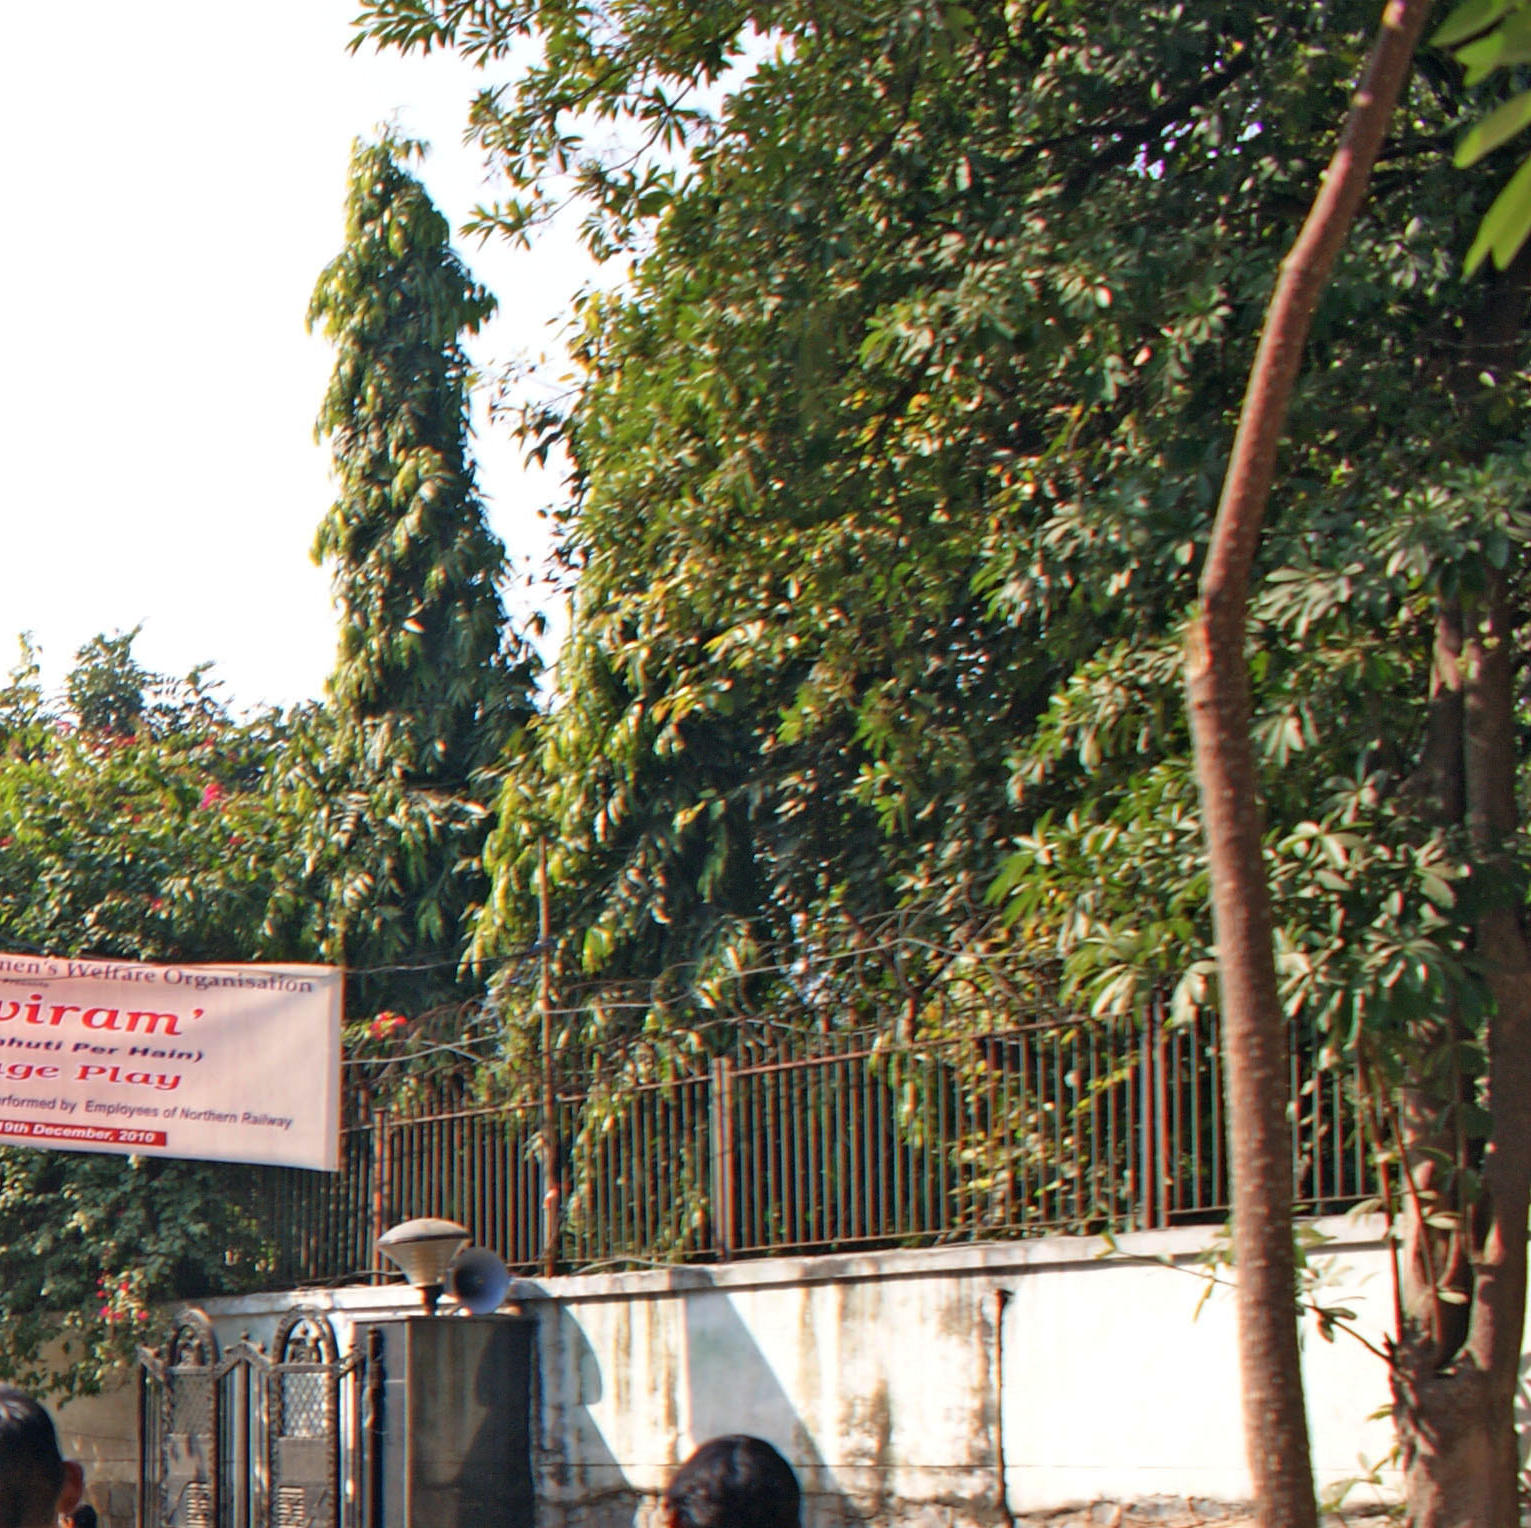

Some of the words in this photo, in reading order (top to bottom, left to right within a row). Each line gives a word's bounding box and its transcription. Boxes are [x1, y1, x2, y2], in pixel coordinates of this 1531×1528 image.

[67, 962, 156, 984] Welfare
[164, 967, 314, 993] Organisation
[72, 1042, 120, 1055] Per
[129, 1045, 205, 1063] Hain)
[76, 1064, 182, 1091] Play
[60, 1099, 77, 1114] by
[85, 1100, 158, 1119] Employees
[163, 1107, 176, 1119] of
[179, 1108, 237, 1124] Northern
[241, 1112, 293, 1130] Railway
[119, 1131, 156, 1144] 2010
